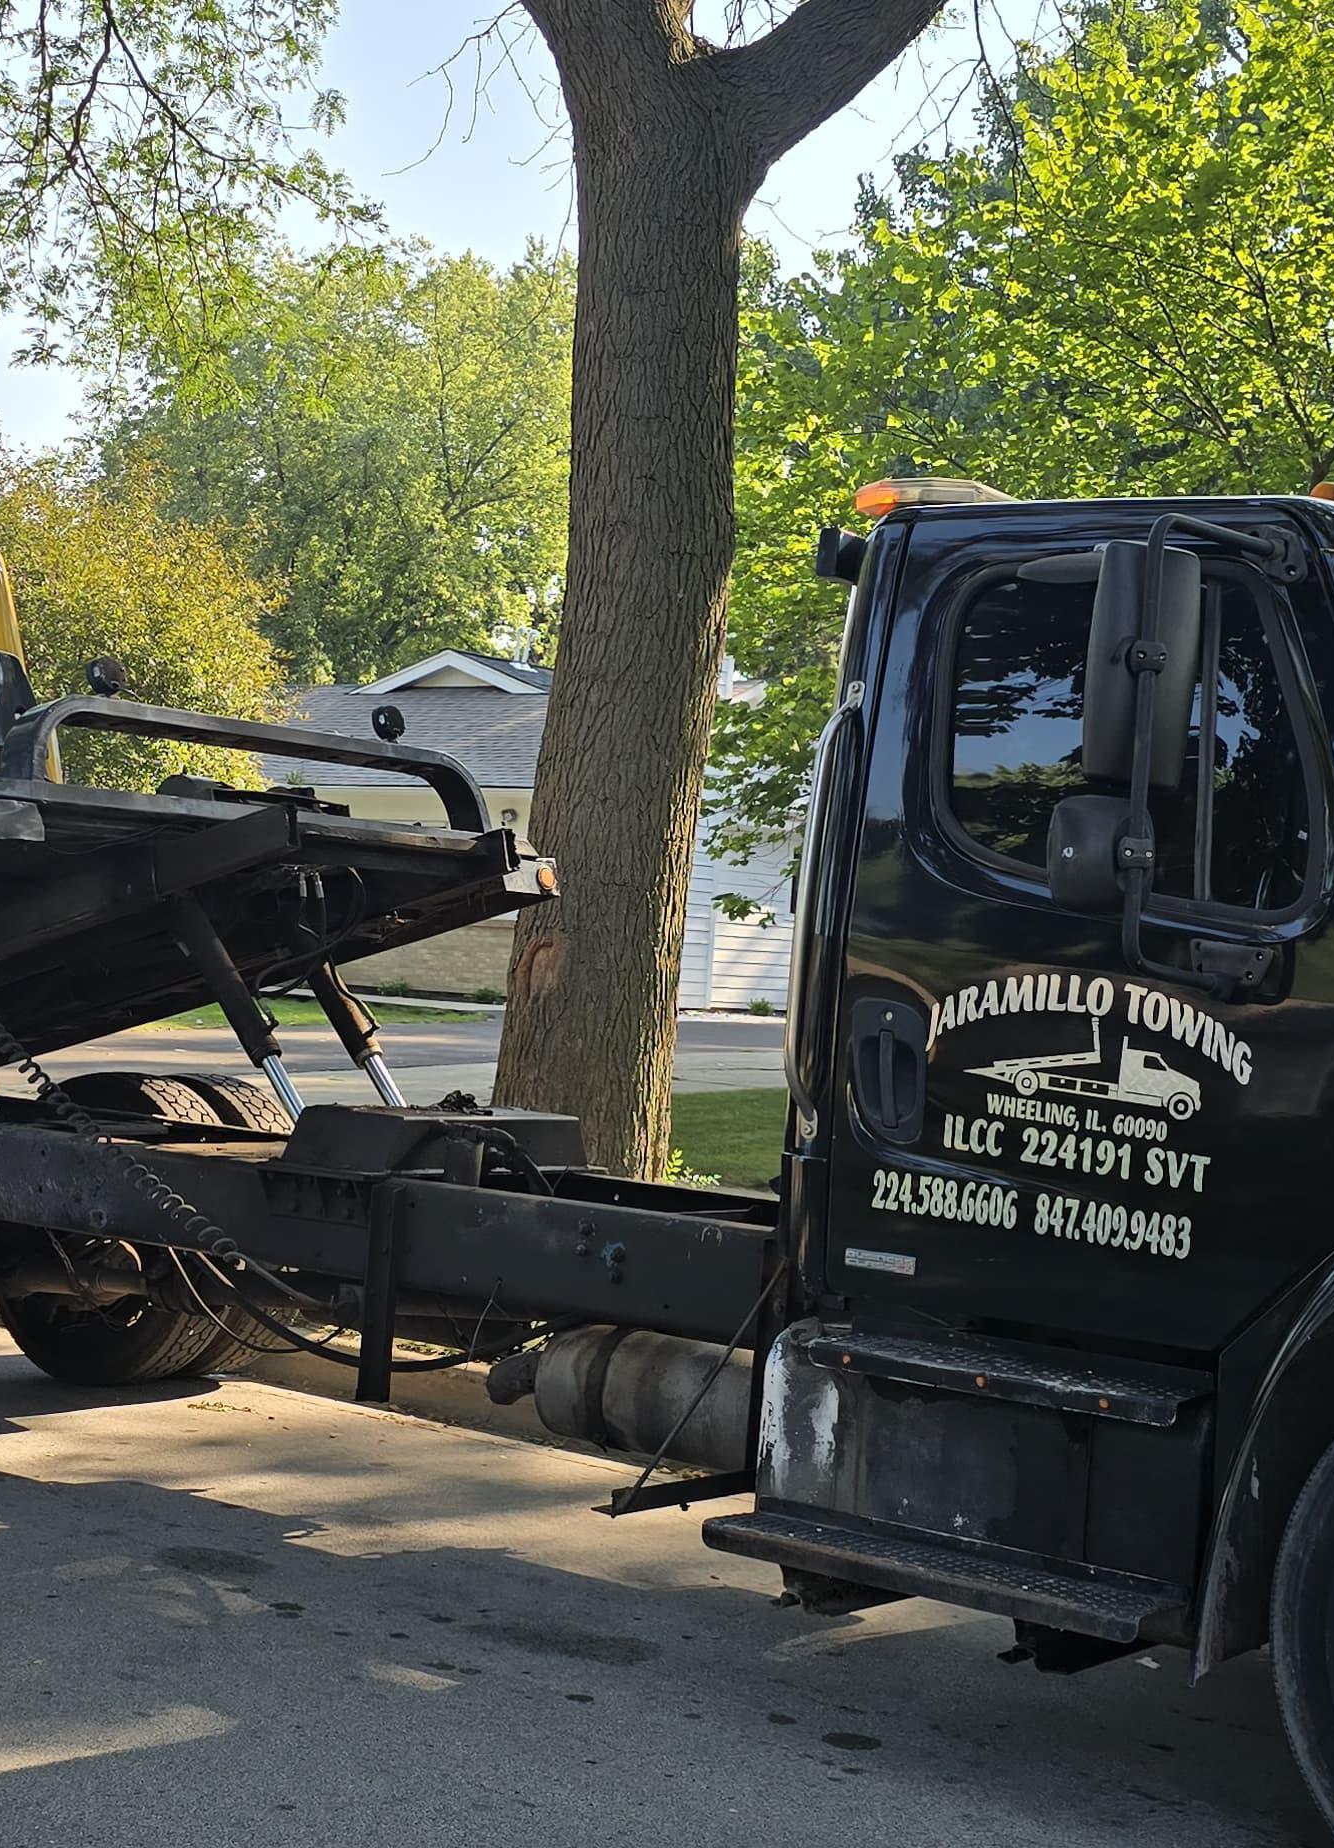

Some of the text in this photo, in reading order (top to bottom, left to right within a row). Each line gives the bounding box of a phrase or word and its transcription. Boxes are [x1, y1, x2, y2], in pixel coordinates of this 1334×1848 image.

[925, 974, 1253, 1085] JARAMILLO TOWING
[943, 1113, 1212, 1193] ILCC 224191 SVT
[987, 1093, 1168, 1142] WHEELING, IL. 60090
[871, 1169, 1192, 1260] 224.588.6606 847.409.9483
